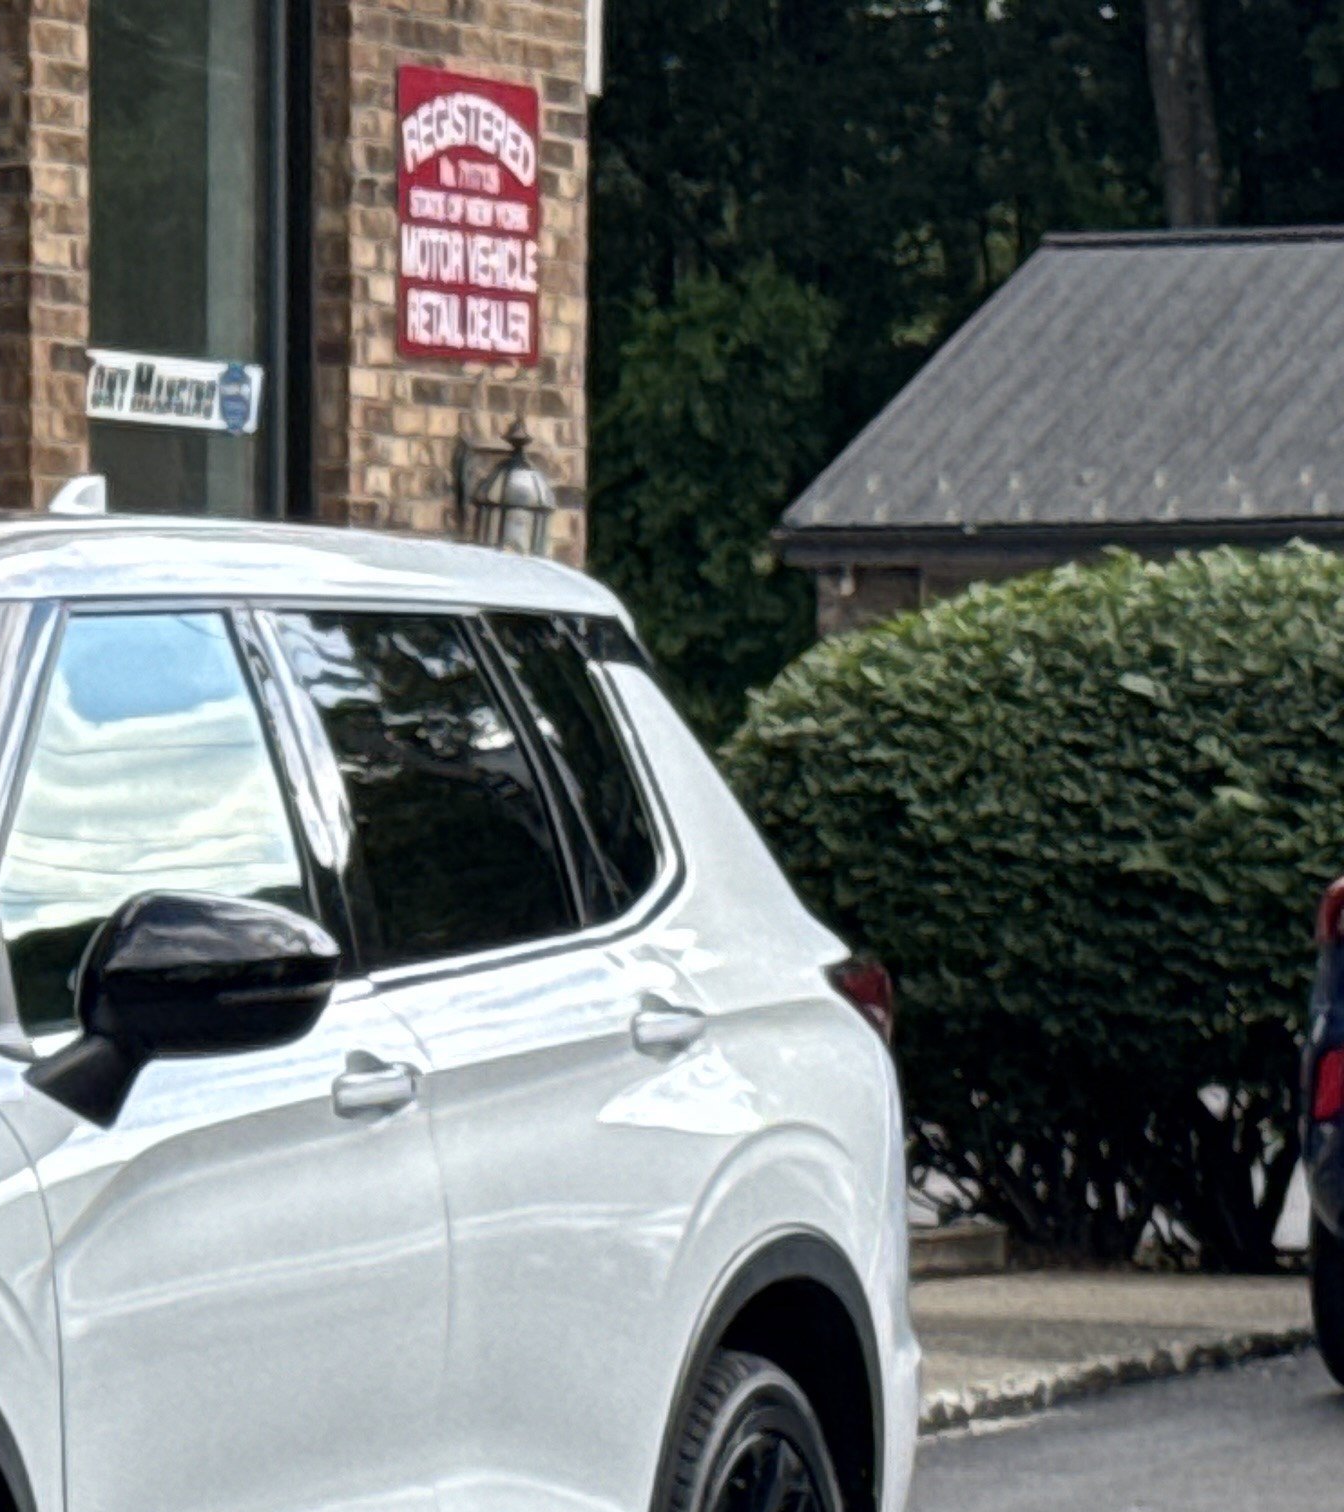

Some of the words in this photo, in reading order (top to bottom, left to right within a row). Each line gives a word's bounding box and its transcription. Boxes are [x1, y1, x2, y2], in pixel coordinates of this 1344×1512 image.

[401, 91, 535, 187] REGISTERED
[401, 223, 463, 284] MOTOR
[465, 231, 538, 293] VEHICLE
[406, 287, 463, 349] RETAIL
[465, 295, 530, 353] DEALER
[90, 363, 132, 411] ONY
